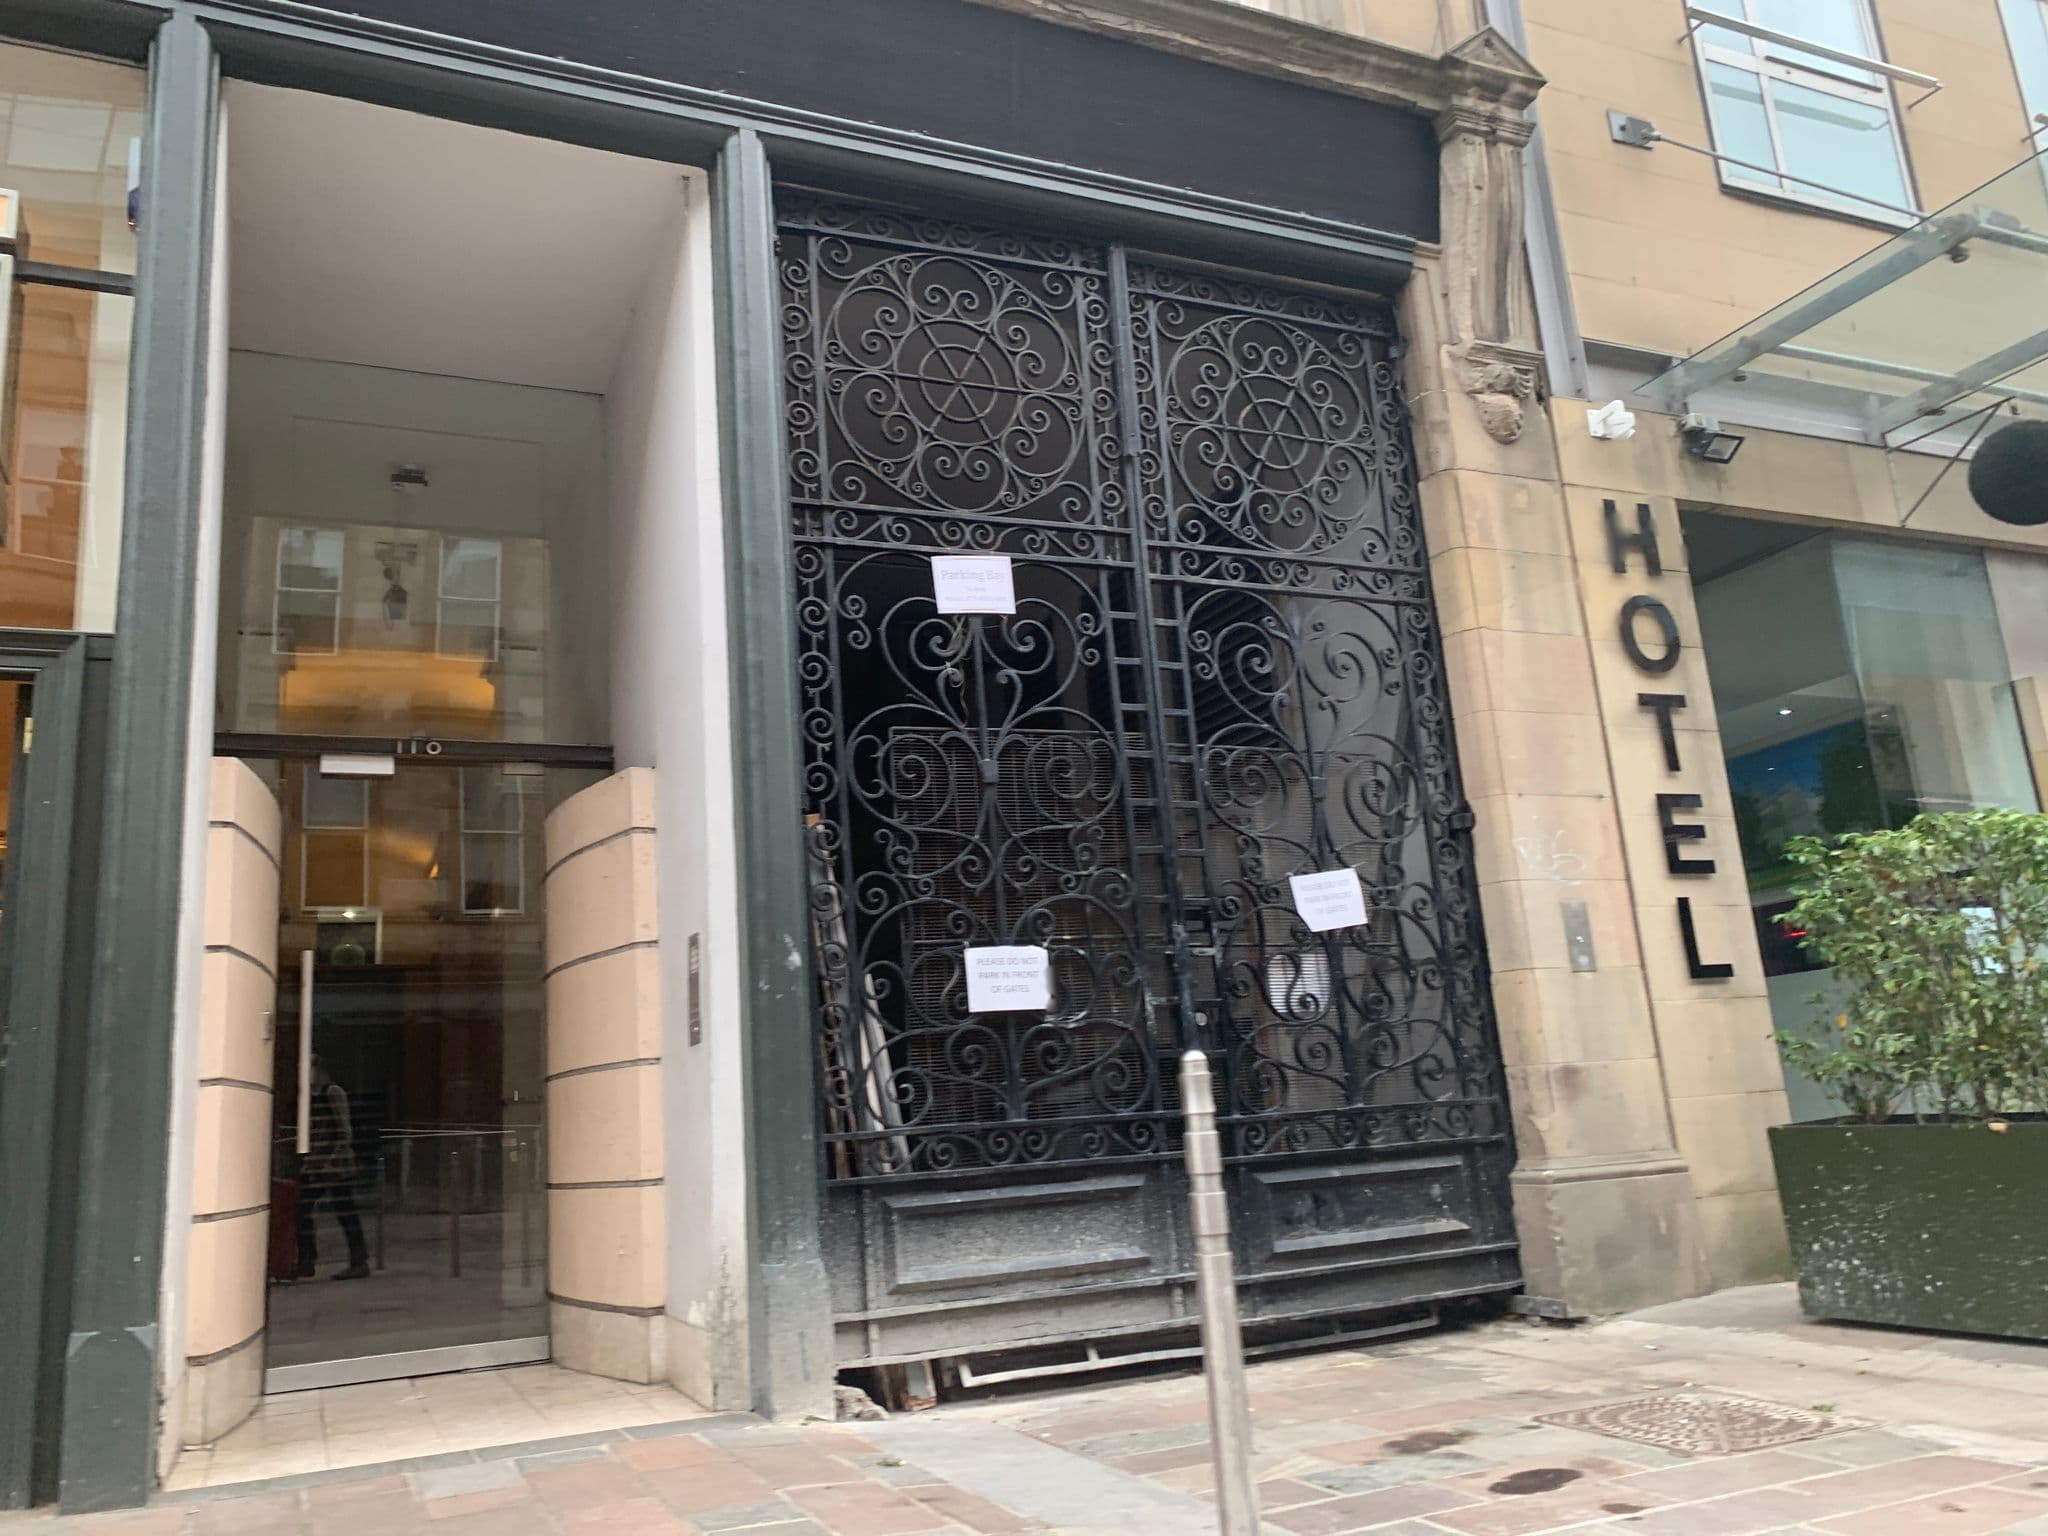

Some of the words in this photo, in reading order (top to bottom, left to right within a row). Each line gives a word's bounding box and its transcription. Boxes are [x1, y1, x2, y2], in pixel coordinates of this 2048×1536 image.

[941, 569, 985, 583] Parking
[986, 569, 1005, 583] Bay
[1603, 499, 1735, 980] HOTEL
[397, 740, 442, 755] 110
[976, 957, 1006, 966] PLEASE
[1007, 957, 1019, 966] DO
[1021, 956, 1039, 965] NOT
[978, 971, 1000, 979] PARK
[1002, 971, 1010, 979] IN
[1012, 970, 1040, 979] FRONT
[991, 985, 1002, 994] OF
[1003, 984, 1031, 993] GATES
